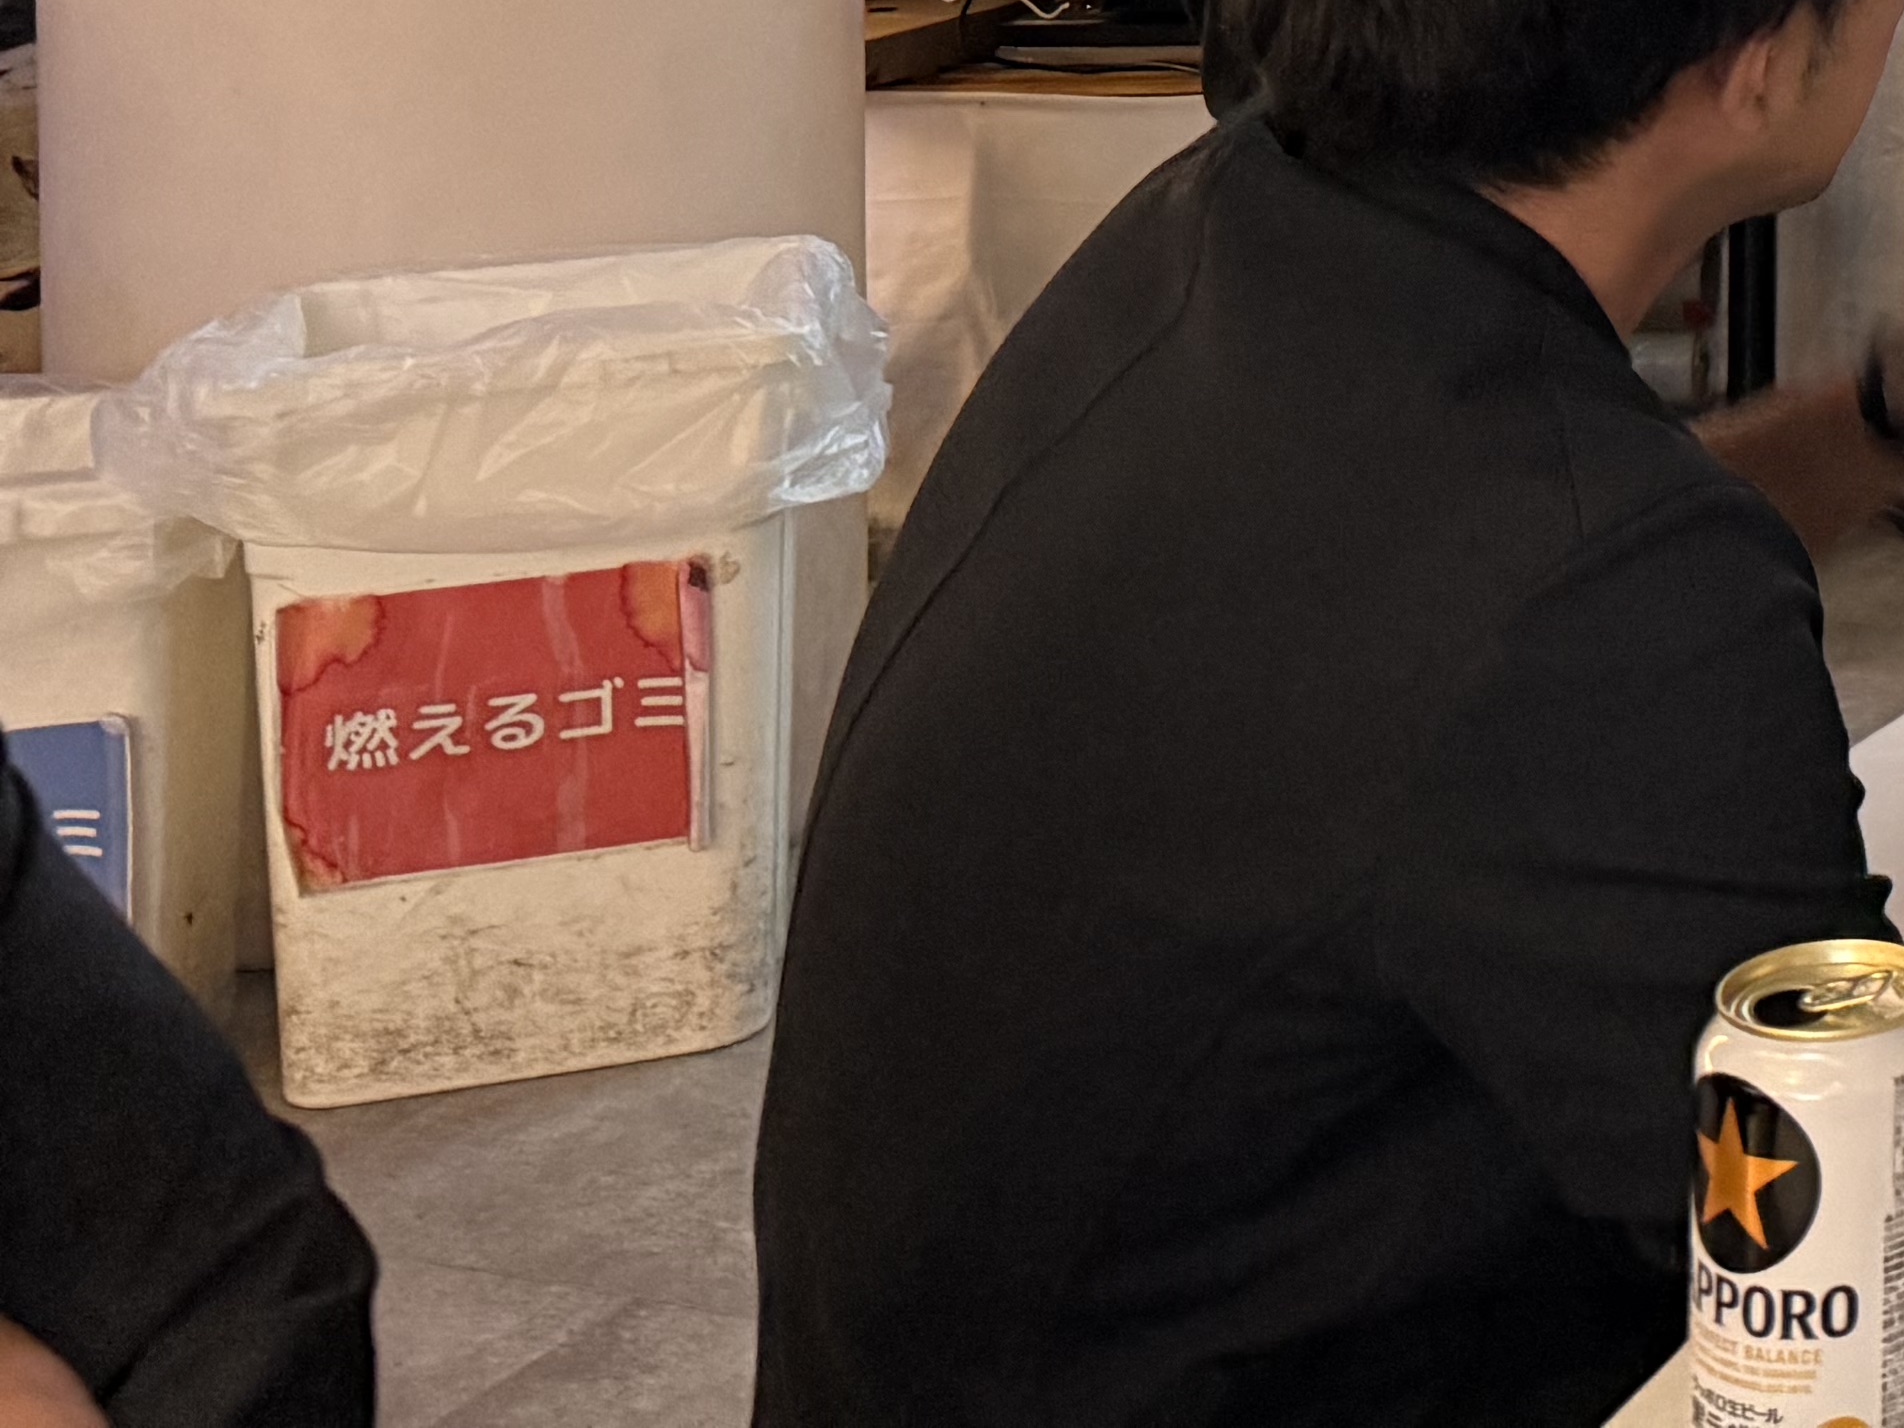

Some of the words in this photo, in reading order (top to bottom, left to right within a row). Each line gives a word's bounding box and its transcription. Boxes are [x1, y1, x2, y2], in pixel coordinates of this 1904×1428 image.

[325, 677, 686, 772] 燃えるゴミ
[1692, 1259, 1860, 1341] PPORO
[1744, 1347, 1824, 1366] BALANCE
